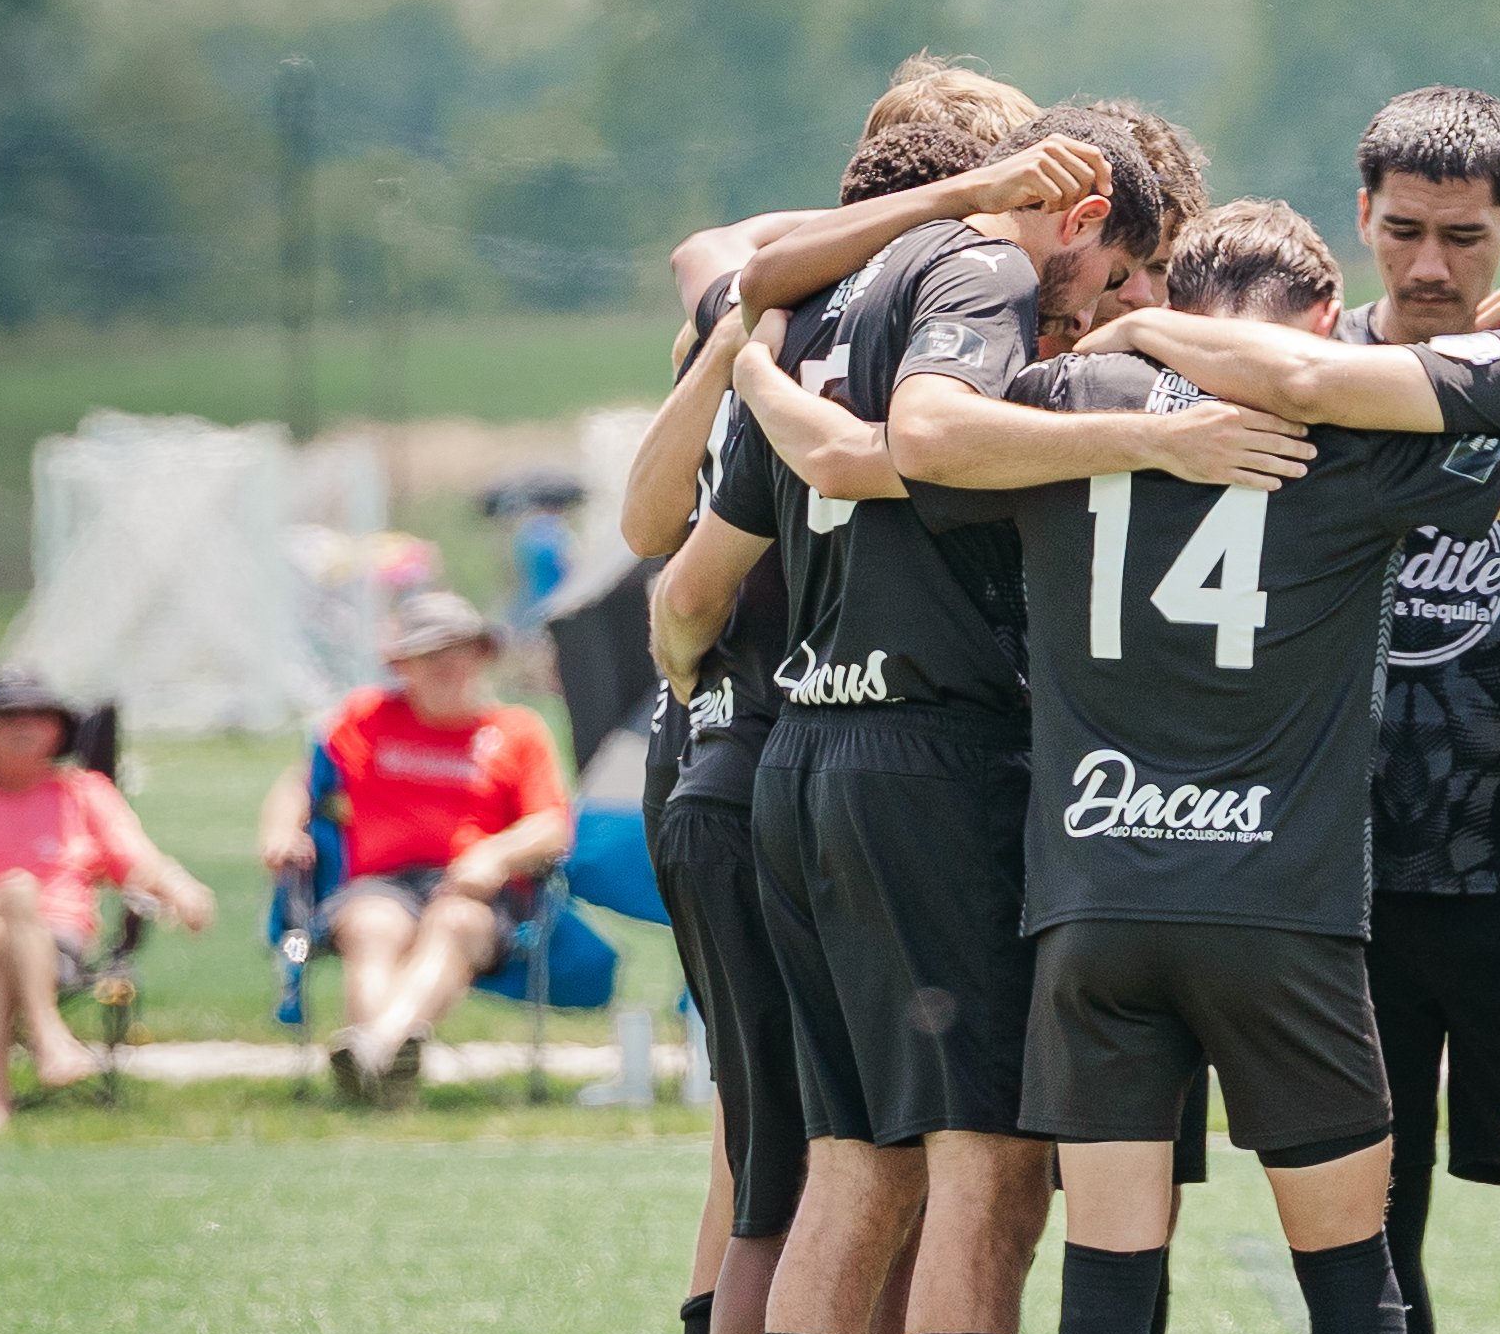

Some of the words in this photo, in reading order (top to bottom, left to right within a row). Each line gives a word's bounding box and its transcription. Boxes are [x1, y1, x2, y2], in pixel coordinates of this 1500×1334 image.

[1088, 471, 1268, 669] 14
[1410, 597, 1490, 624] Tequila
[1063, 748, 1272, 838] Dacus
[1103, 826, 1131, 838] AUTO
[1131, 827, 1164, 839] BODY
[1165, 828, 1174, 839] &
[1175, 828, 1235, 842] COLLISION
[1236, 830, 1274, 844] REPAIR
